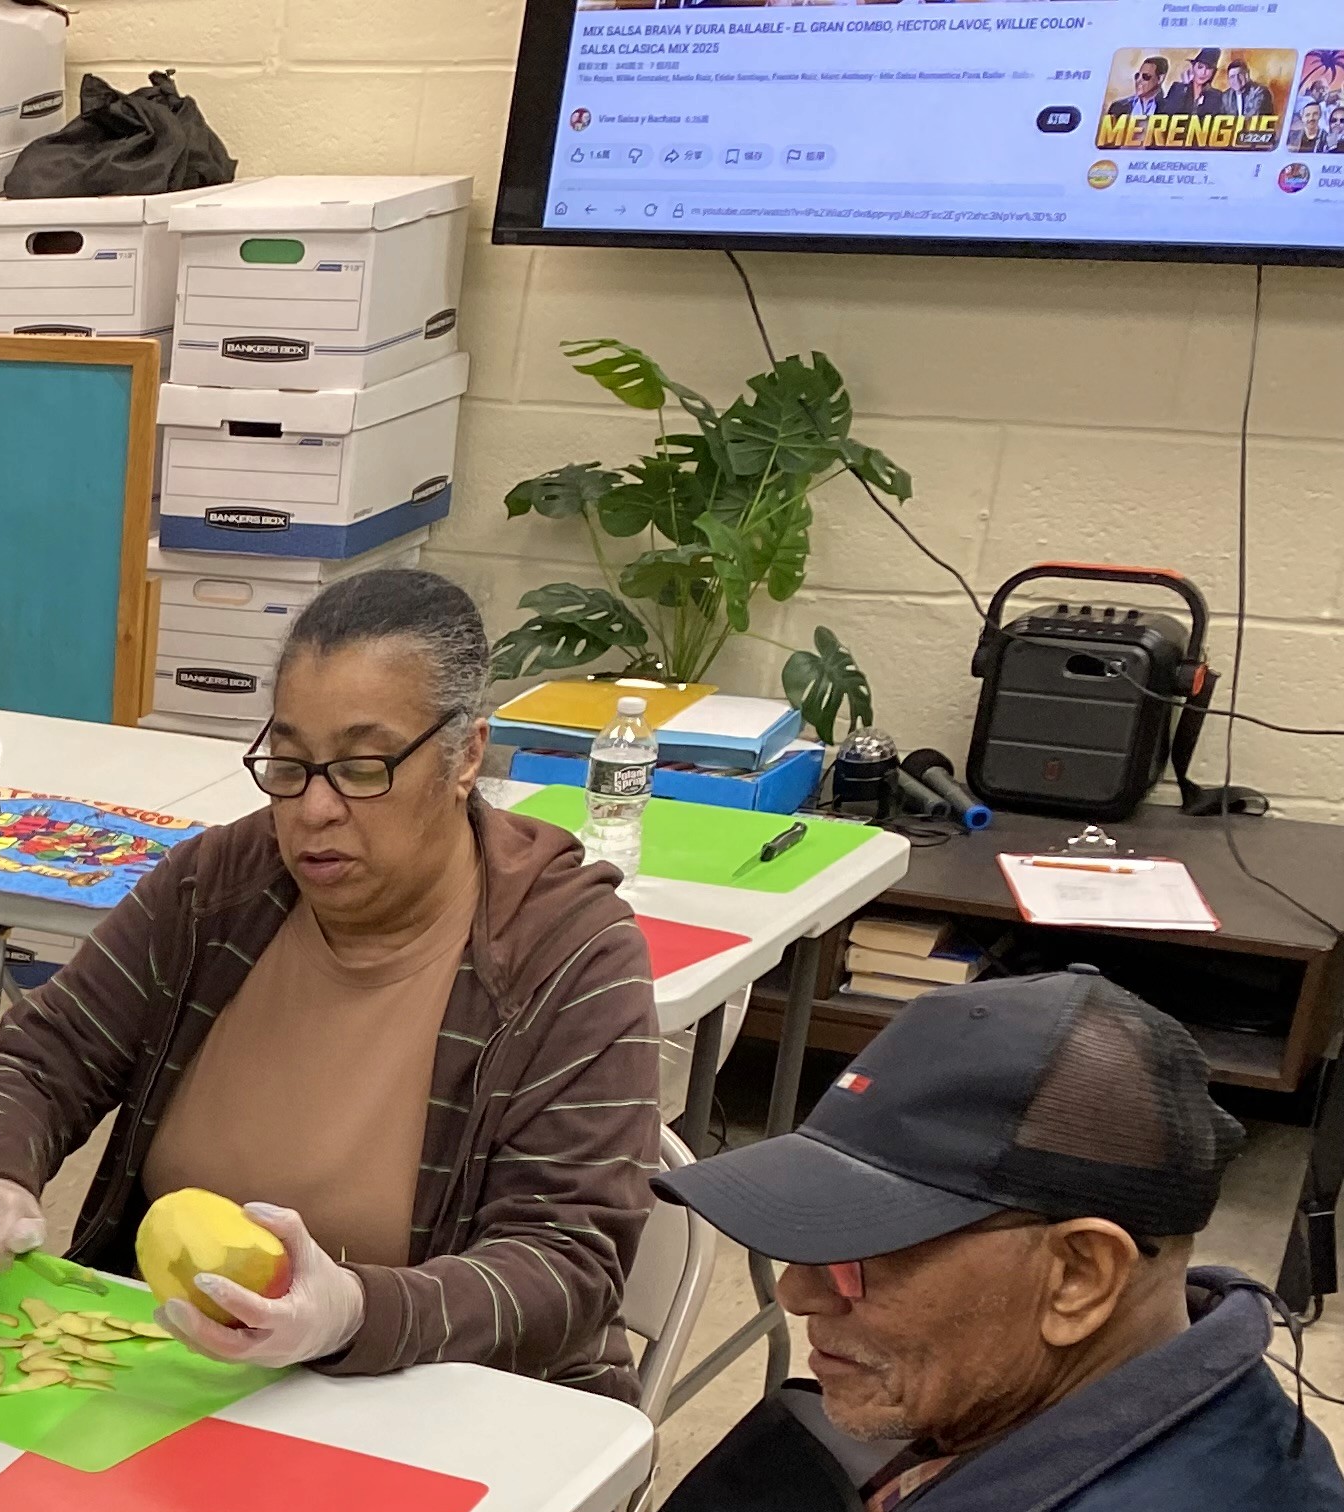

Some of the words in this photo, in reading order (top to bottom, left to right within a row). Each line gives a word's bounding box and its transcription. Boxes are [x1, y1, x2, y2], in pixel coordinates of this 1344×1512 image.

[583, 25, 604, 36] MIX
[607, 25, 642, 36] SALSA
[645, 24, 682, 36] BRAVA
[685, 24, 694, 35] Y
[695, 23, 726, 35] DURA
[729, 22, 785, 34] BAILABLE
[793, 22, 807, 33] EL
[811, 21, 844, 33] GRAN
[846, 20, 894, 33] COMBO,
[897, 19, 947, 31] HECTOR
[949, 18, 992, 32] LAVOE,
[996, 18, 1037, 30] WILLIE
[1040, 17, 1085, 29] COLON
[580, 44, 616, 55] SALSA
[618, 43, 666, 55] CLASICA
[668, 43, 689, 54] MIX
[692, 42, 720, 54] 2025
[1097, 113, 1279, 147] MERENGUE
[1128, 162, 1148, 171] MIX
[1150, 161, 1208, 171] MERENGUE
[1321, 165, 1342, 174] MIX
[1125, 174, 1174, 184] BAILABLE
[226, 343, 279, 354] BANKERS
[279, 345, 305, 354] BOX
[209, 513, 261, 524] BANKERS
[261, 515, 286, 526] BOX
[180, 673, 229, 687] BANKERS
[229, 678, 253, 688] BOX
